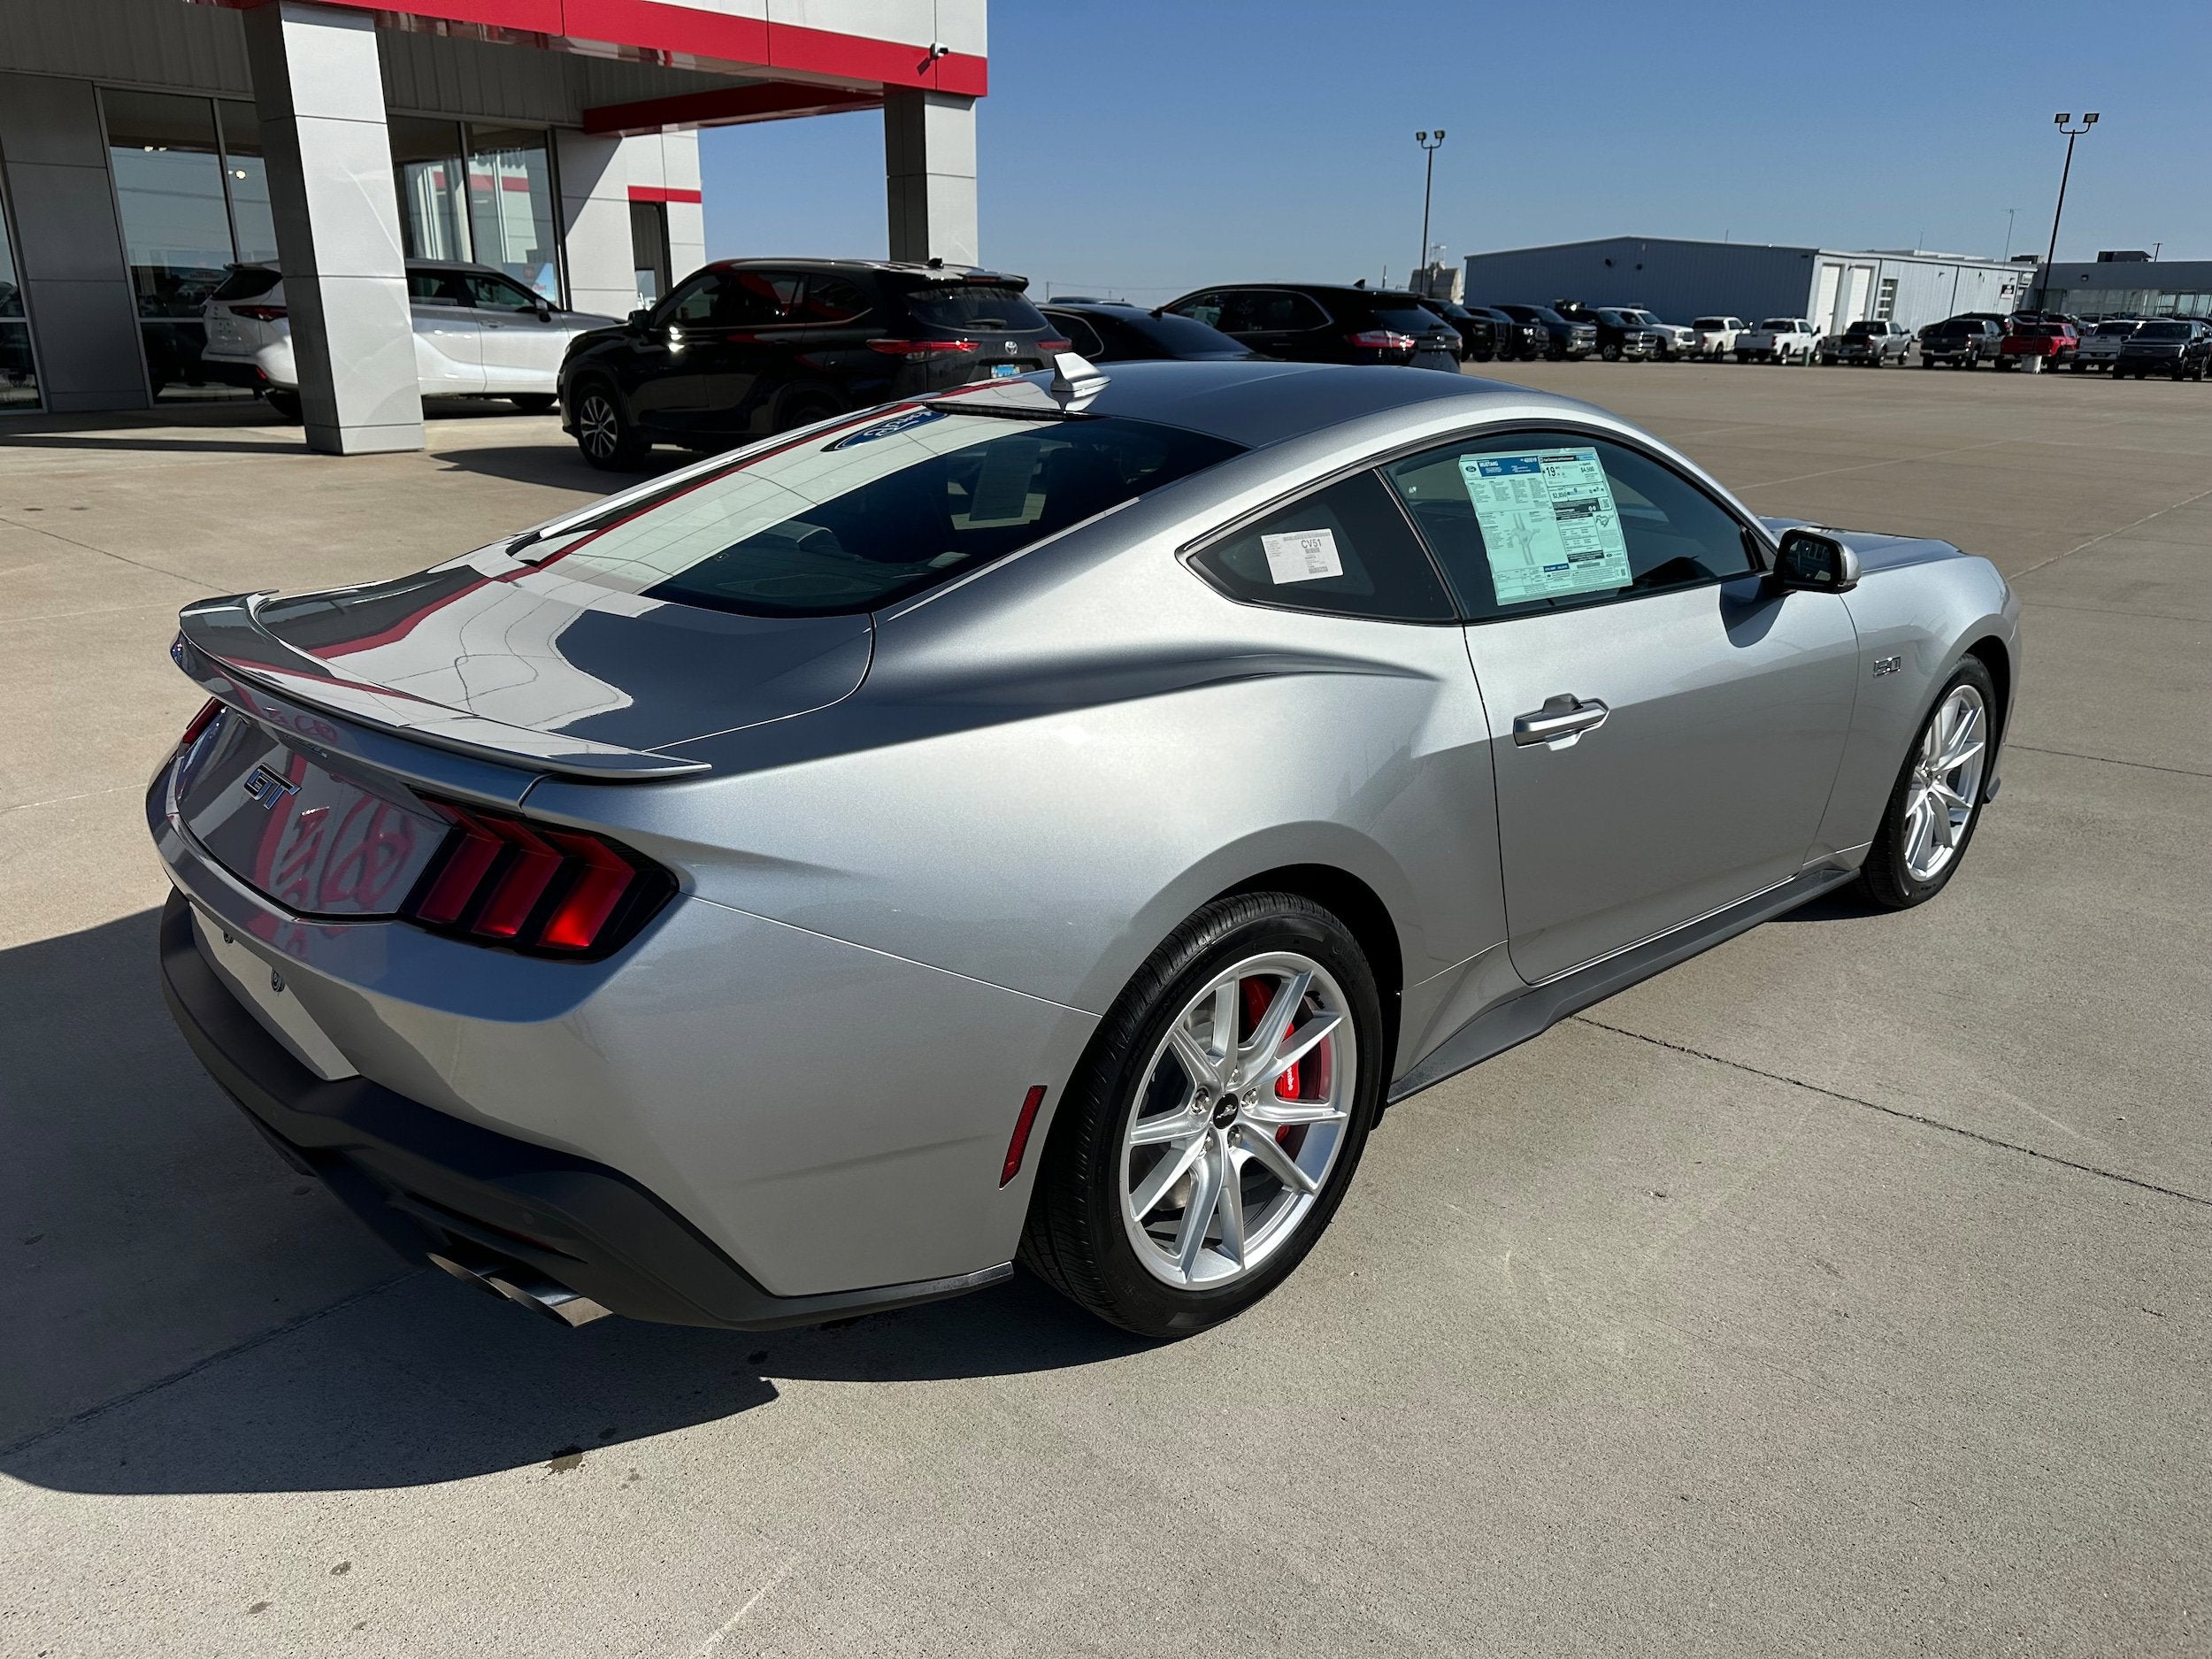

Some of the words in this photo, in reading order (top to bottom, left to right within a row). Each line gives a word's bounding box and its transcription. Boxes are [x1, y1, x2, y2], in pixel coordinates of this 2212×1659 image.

[1546, 466, 1556, 477] 19
[1301, 538, 1322, 549] CV51
[243, 763, 302, 810] GT
